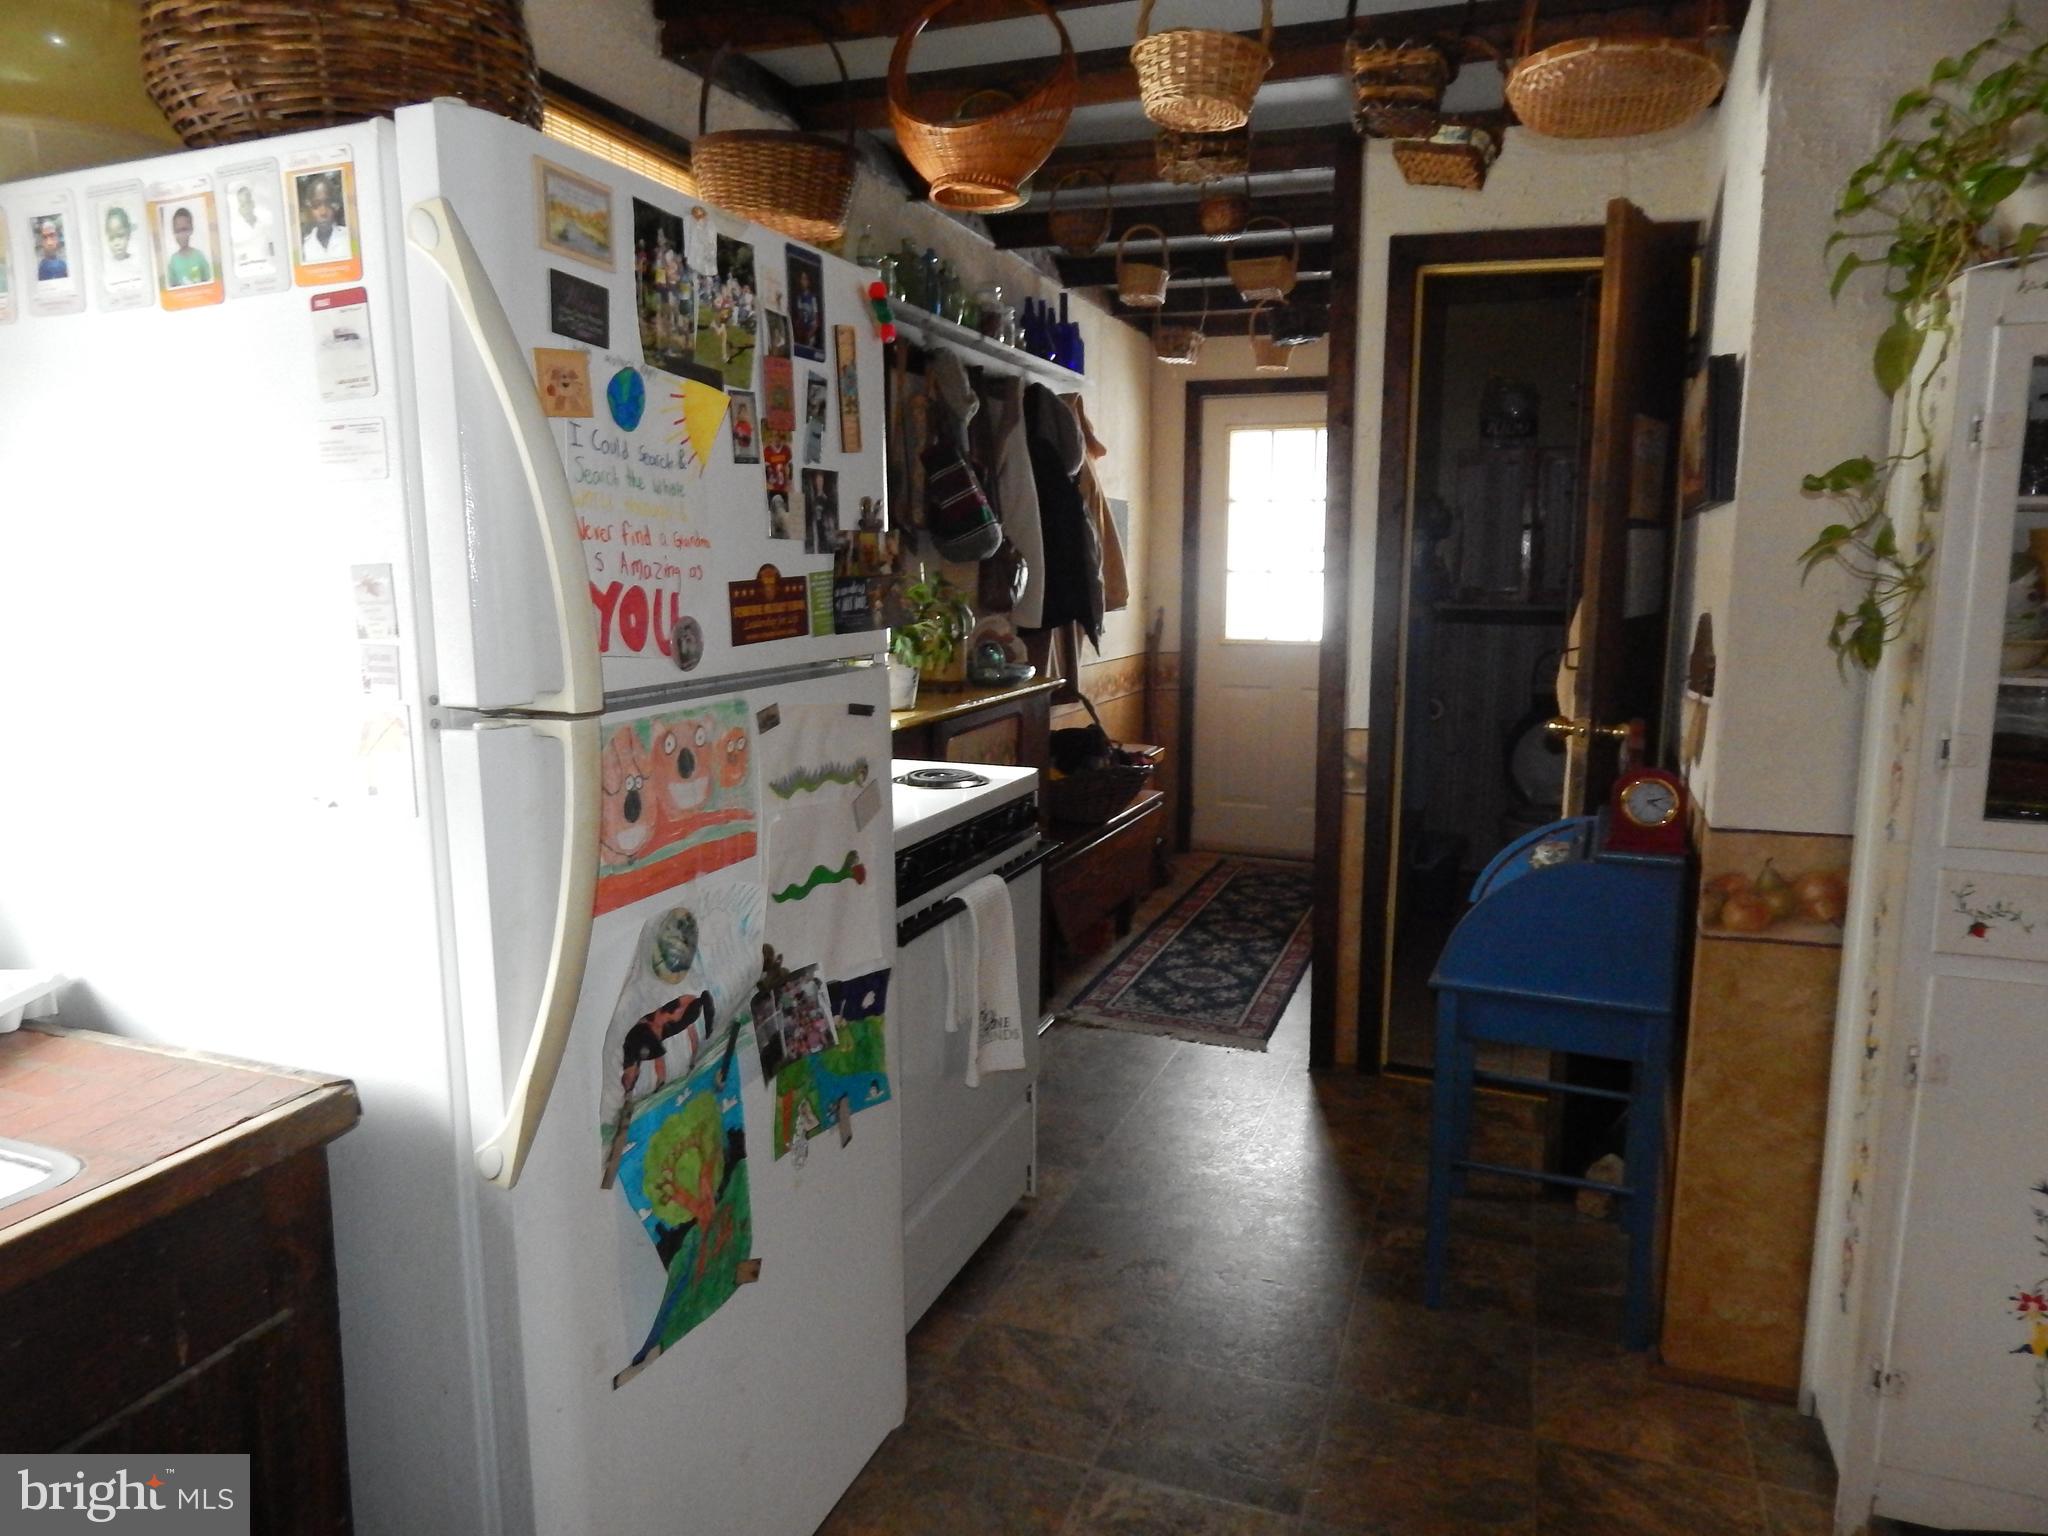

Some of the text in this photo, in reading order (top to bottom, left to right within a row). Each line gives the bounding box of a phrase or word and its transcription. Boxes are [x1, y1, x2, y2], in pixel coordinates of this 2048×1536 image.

[568, 420, 584, 448] I
[591, 429, 629, 460] Could
[574, 456, 619, 487] Search
[588, 580, 681, 658] YOU
